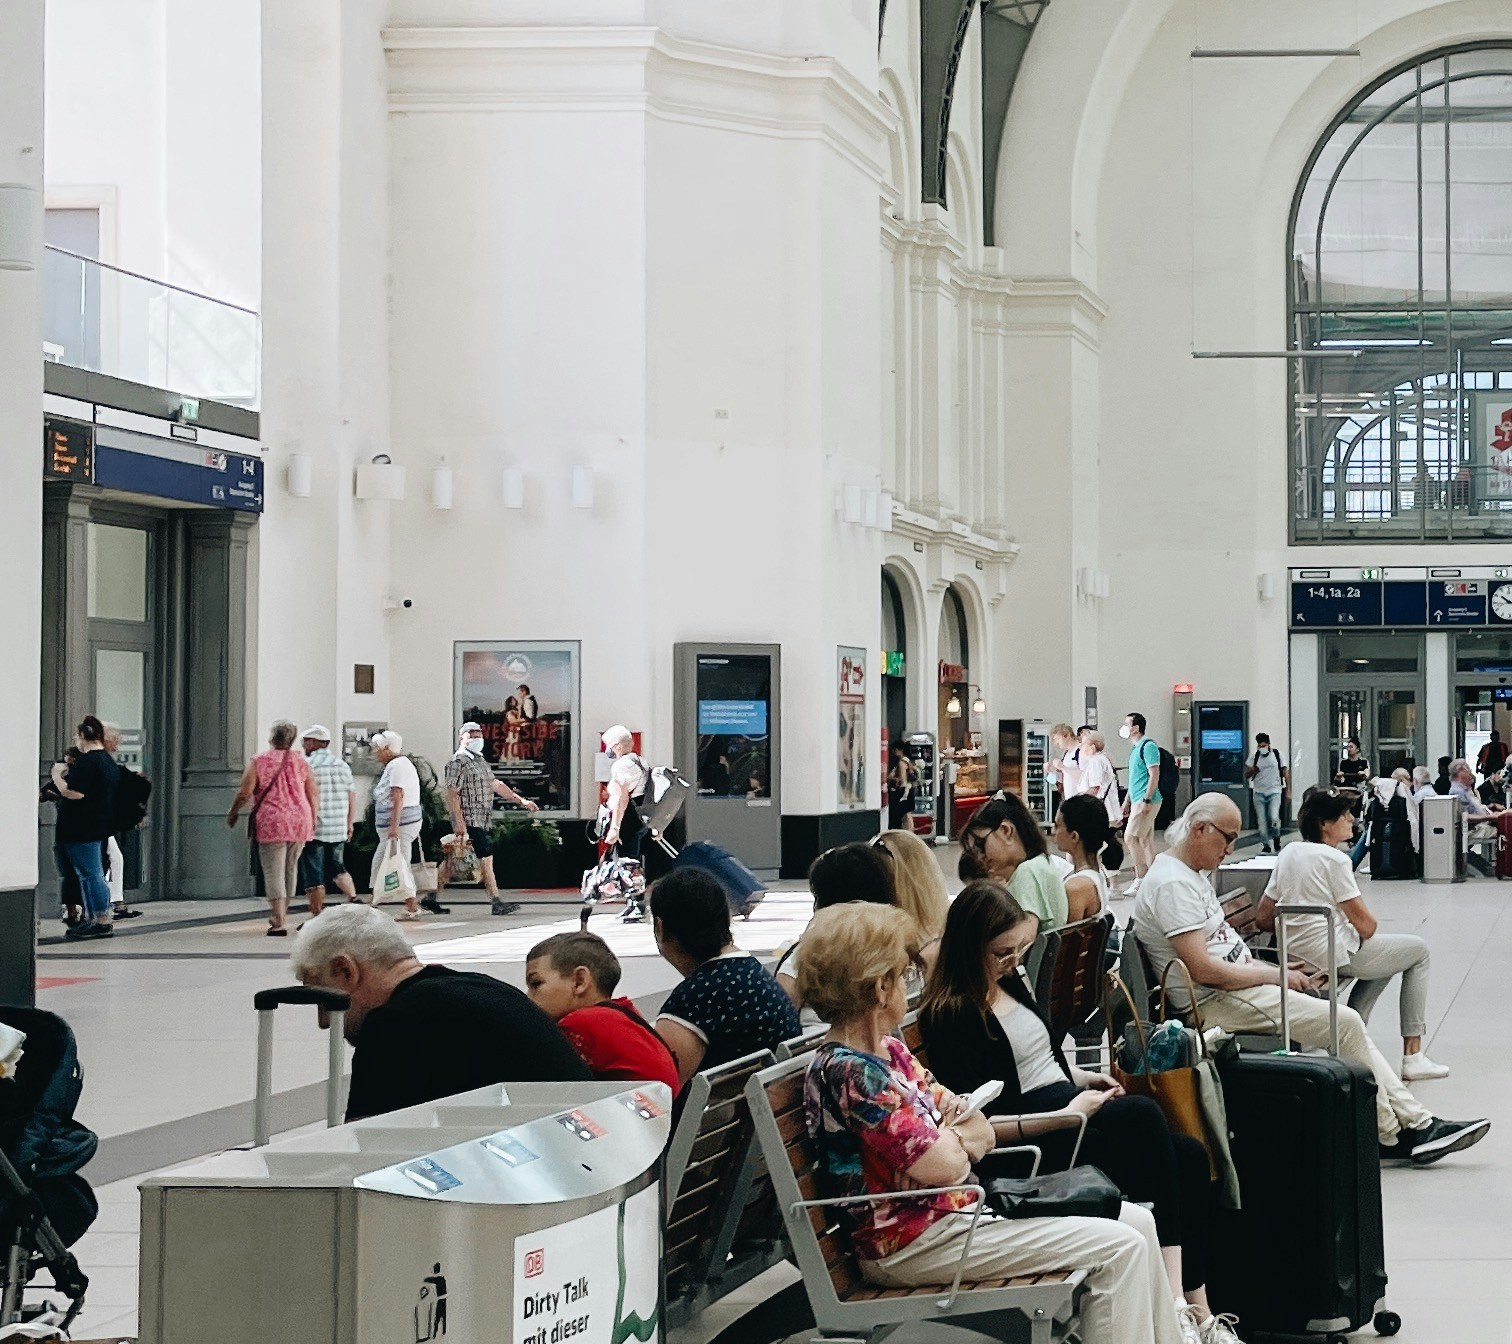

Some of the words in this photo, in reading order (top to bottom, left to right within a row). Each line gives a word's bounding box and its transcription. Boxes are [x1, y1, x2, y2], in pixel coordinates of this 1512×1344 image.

[1308, 587, 1329, 599] 1-4,
[1347, 586, 1361, 598] 2a
[523, 1291, 560, 1319] Dirty
[563, 1276, 589, 1304] Talk
[550, 1314, 590, 1344] dieser
